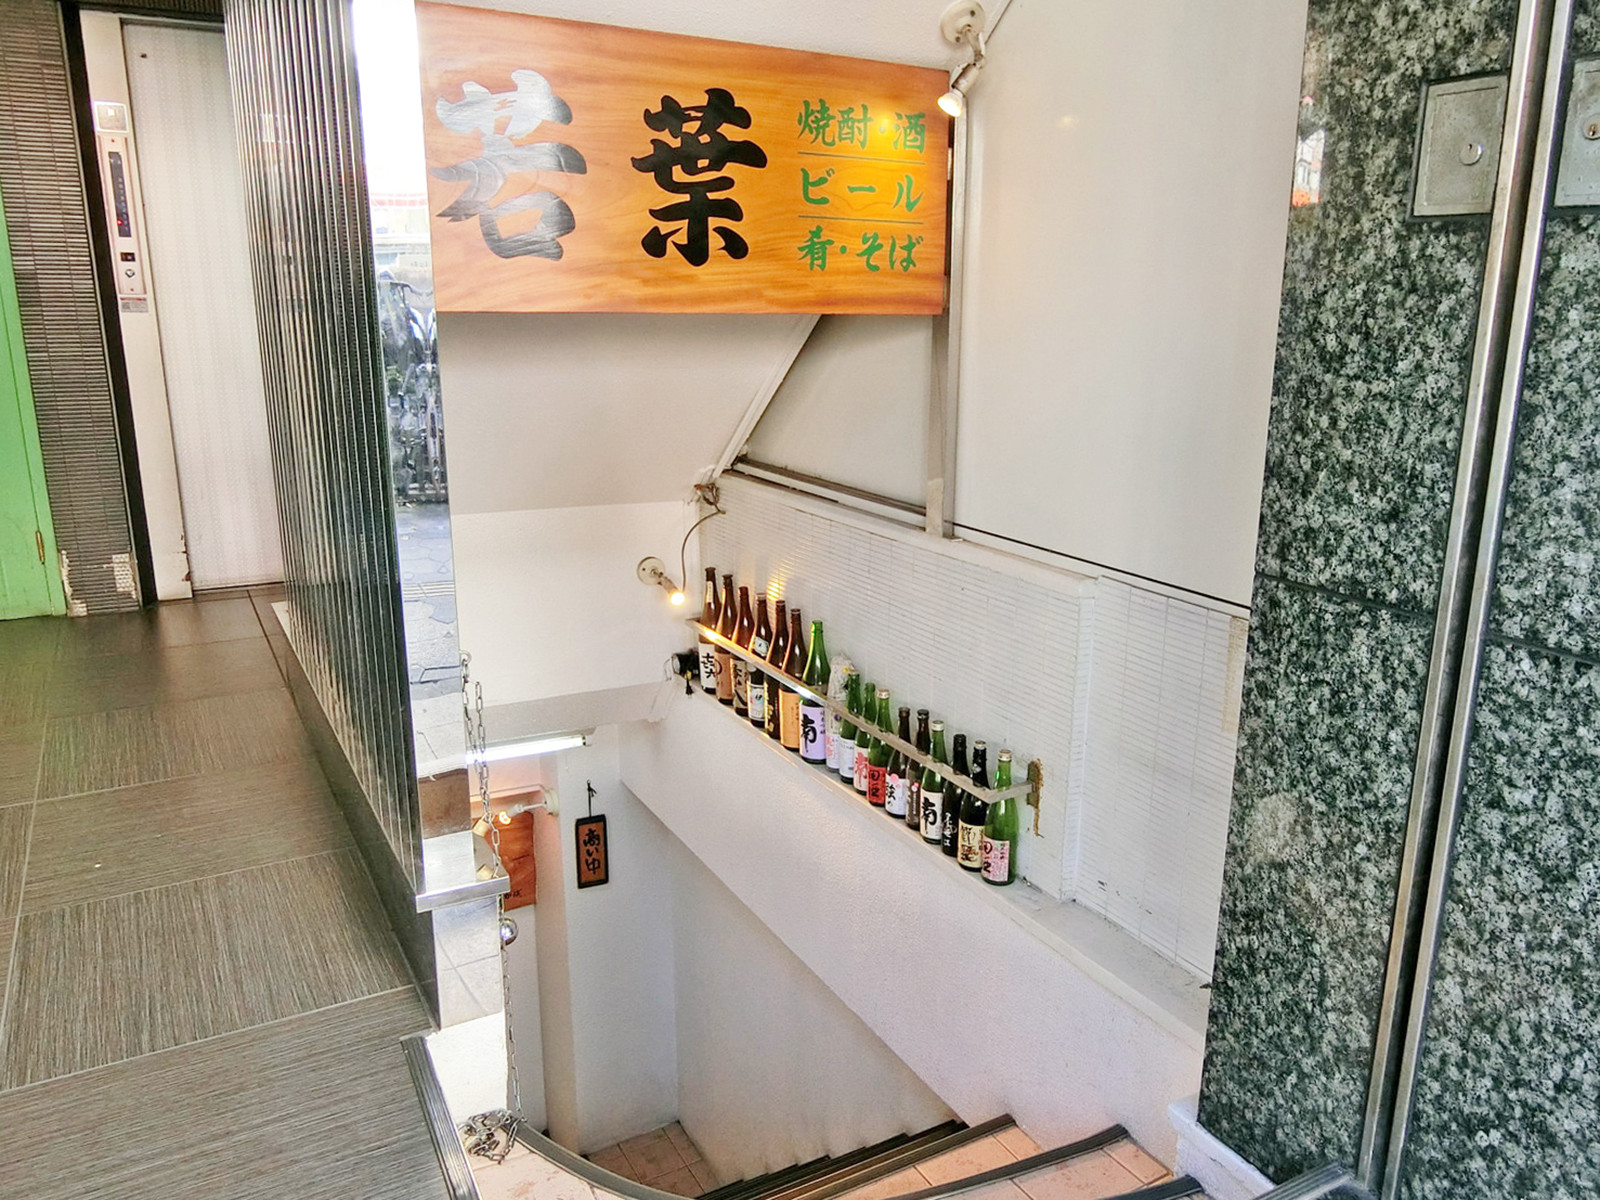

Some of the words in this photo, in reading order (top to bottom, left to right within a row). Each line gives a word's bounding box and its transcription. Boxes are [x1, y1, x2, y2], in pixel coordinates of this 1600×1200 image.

[429, 68, 768, 267] 若葉
[798, 167, 925, 213] ビール
